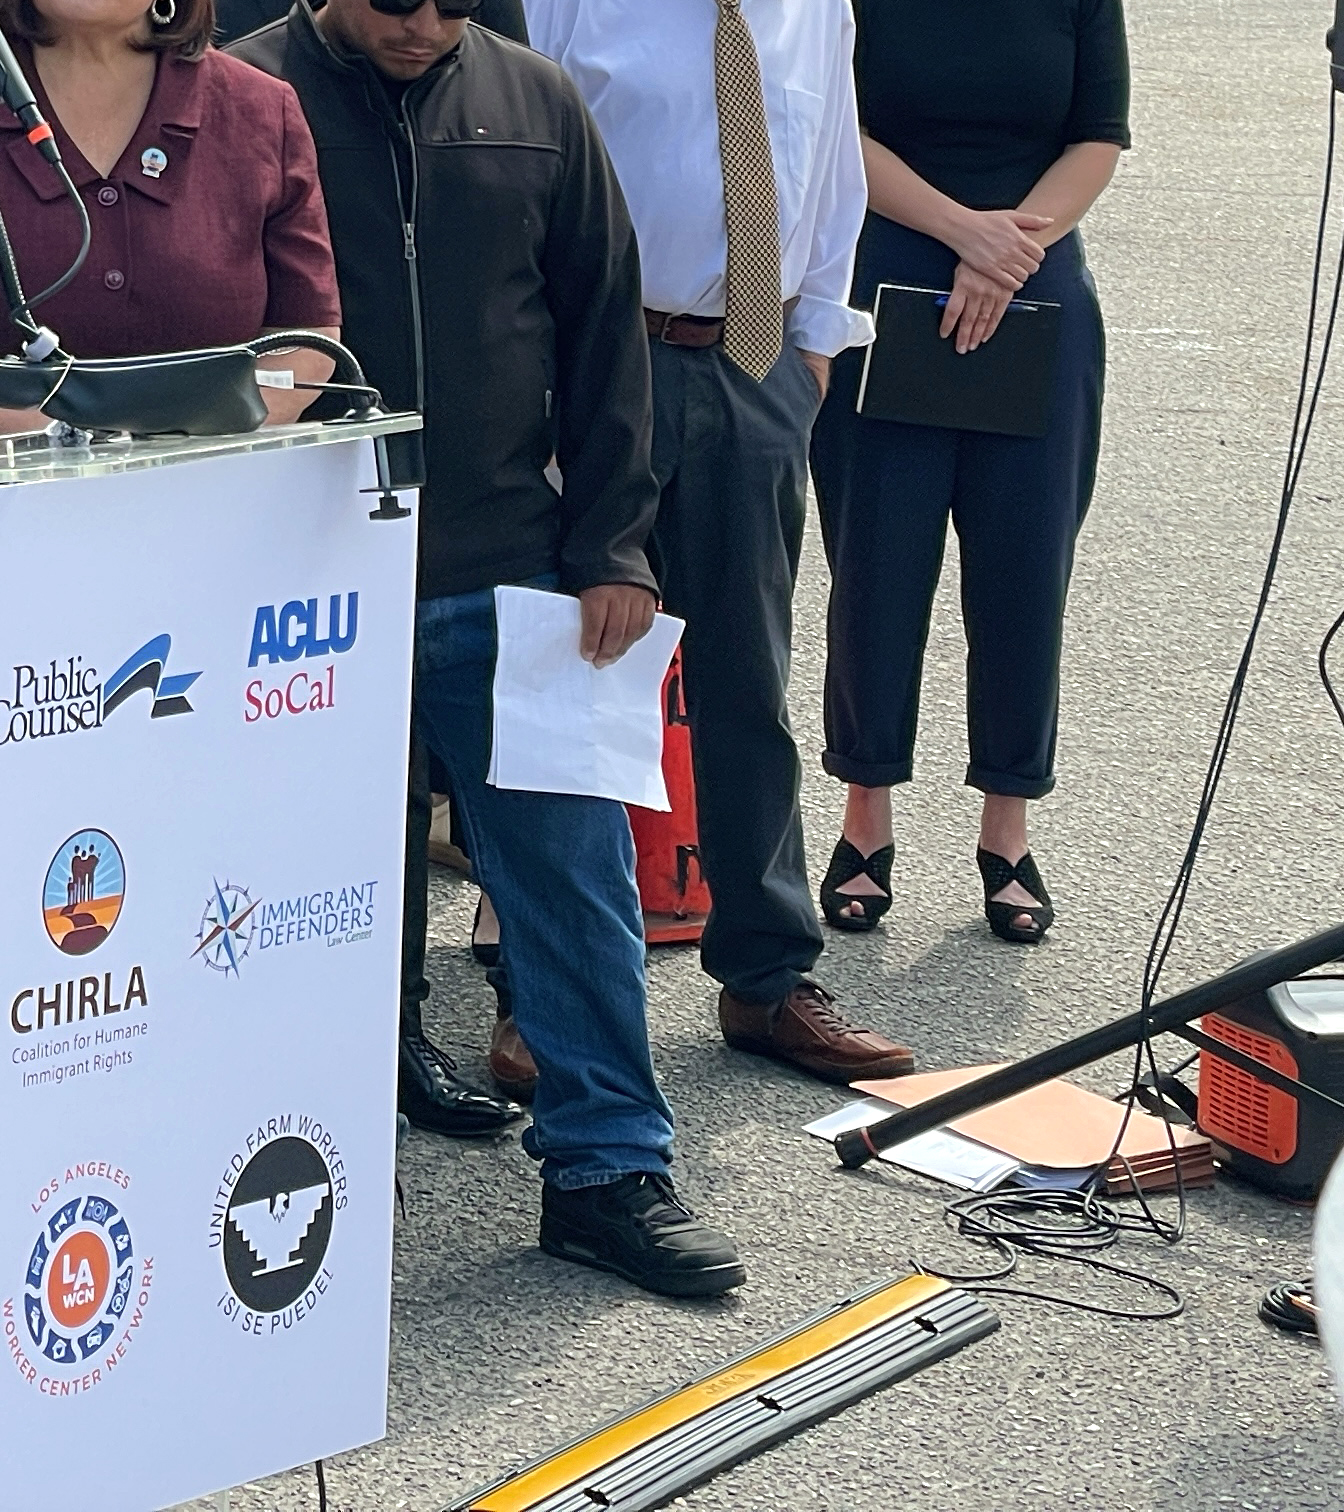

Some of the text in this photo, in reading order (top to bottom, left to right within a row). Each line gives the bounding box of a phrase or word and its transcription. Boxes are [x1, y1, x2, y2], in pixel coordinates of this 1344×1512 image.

[247, 591, 359, 668] ACLU
[12, 656, 99, 708] Public
[244, 665, 335, 723] SoCal
[259, 904, 374, 950] DEFENDERS
[261, 881, 378, 926] IMMIGRANT
[326, 928, 373, 948] Law Center
[11, 966, 148, 1035] CHIRLA
[12, 1021, 148, 1065] Coalition for Humane
[22, 1050, 133, 1088] Immigrant Rights
[31, 1161, 131, 1214] LOS ANGELES
[209, 1113, 349, 1248] UNITED FARM WORKERS
[62, 1254, 95, 1292] LA
[62, 1287, 95, 1309] WCN
[4, 1256, 155, 1397] WORKER CENTER NETWORK
[242, 1312, 263, 1336] SE
[270, 1270, 334, 1336] PUEDE!
